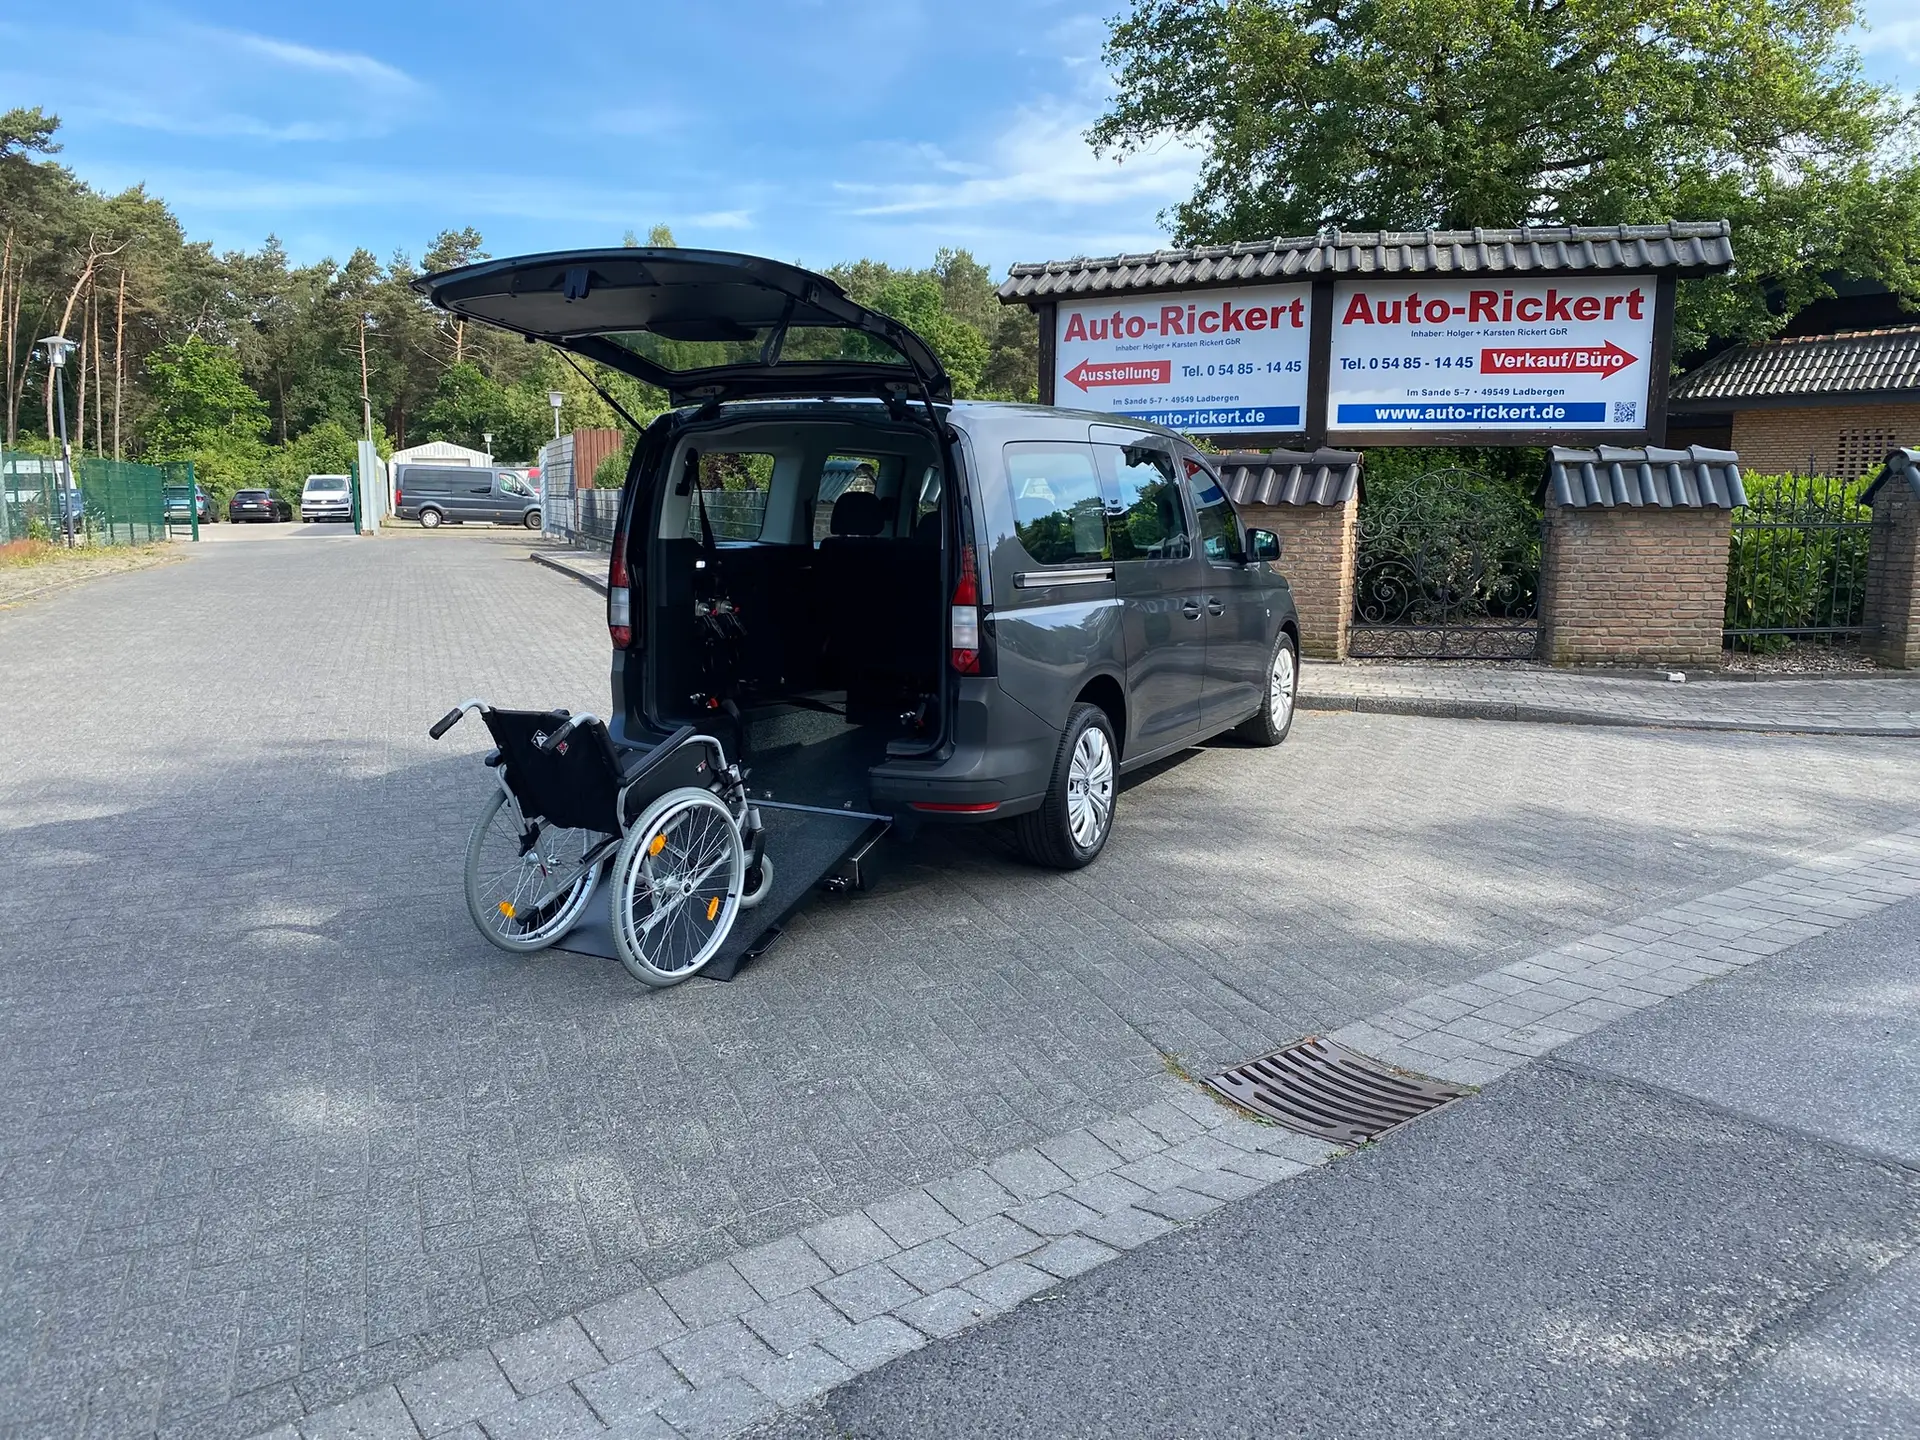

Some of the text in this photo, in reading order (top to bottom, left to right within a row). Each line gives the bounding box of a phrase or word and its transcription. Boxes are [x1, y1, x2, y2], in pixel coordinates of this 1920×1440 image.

[1342, 288, 1645, 324] Auto-Rickert
[1064, 297, 1304, 342] Auto-Rickert
[1411, 329, 1444, 337] Inhaber:
[1446, 329, 1474, 338] Holger
[1483, 328, 1515, 336] Karsten
[1517, 328, 1548, 336] Rickert
[1549, 327, 1568, 336] GbR
[1143, 343, 1165, 351] Holger
[1340, 357, 1365, 370] Tel.
[1369, 357, 1379, 370] 0
[1382, 357, 1400, 370] 54
[1403, 356, 1421, 369] 85
[1435, 356, 1452, 369] 14
[1455, 356, 1473, 368] 45
[1492, 352, 1624, 369] Verkauf/Büro
[1078, 368, 1160, 382] Ausstellung
[1182, 365, 1203, 377] Tel.
[1207, 365, 1215, 376] 0
[1218, 364, 1234, 375] 54
[1238, 363, 1253, 374] 85
[1266, 362, 1282, 373] 14
[1285, 361, 1302, 372] 45
[1407, 389, 1418, 397] Im
[1421, 388, 1451, 397] Sande
[1481, 387, 1510, 396] 49549
[1513, 387, 1565, 397] Ladbergen
[1124, 397, 1147, 405] Sande
[1196, 394, 1239, 403] Ladbergen
[1375, 404, 1566, 420] www.auto-rickert.de
